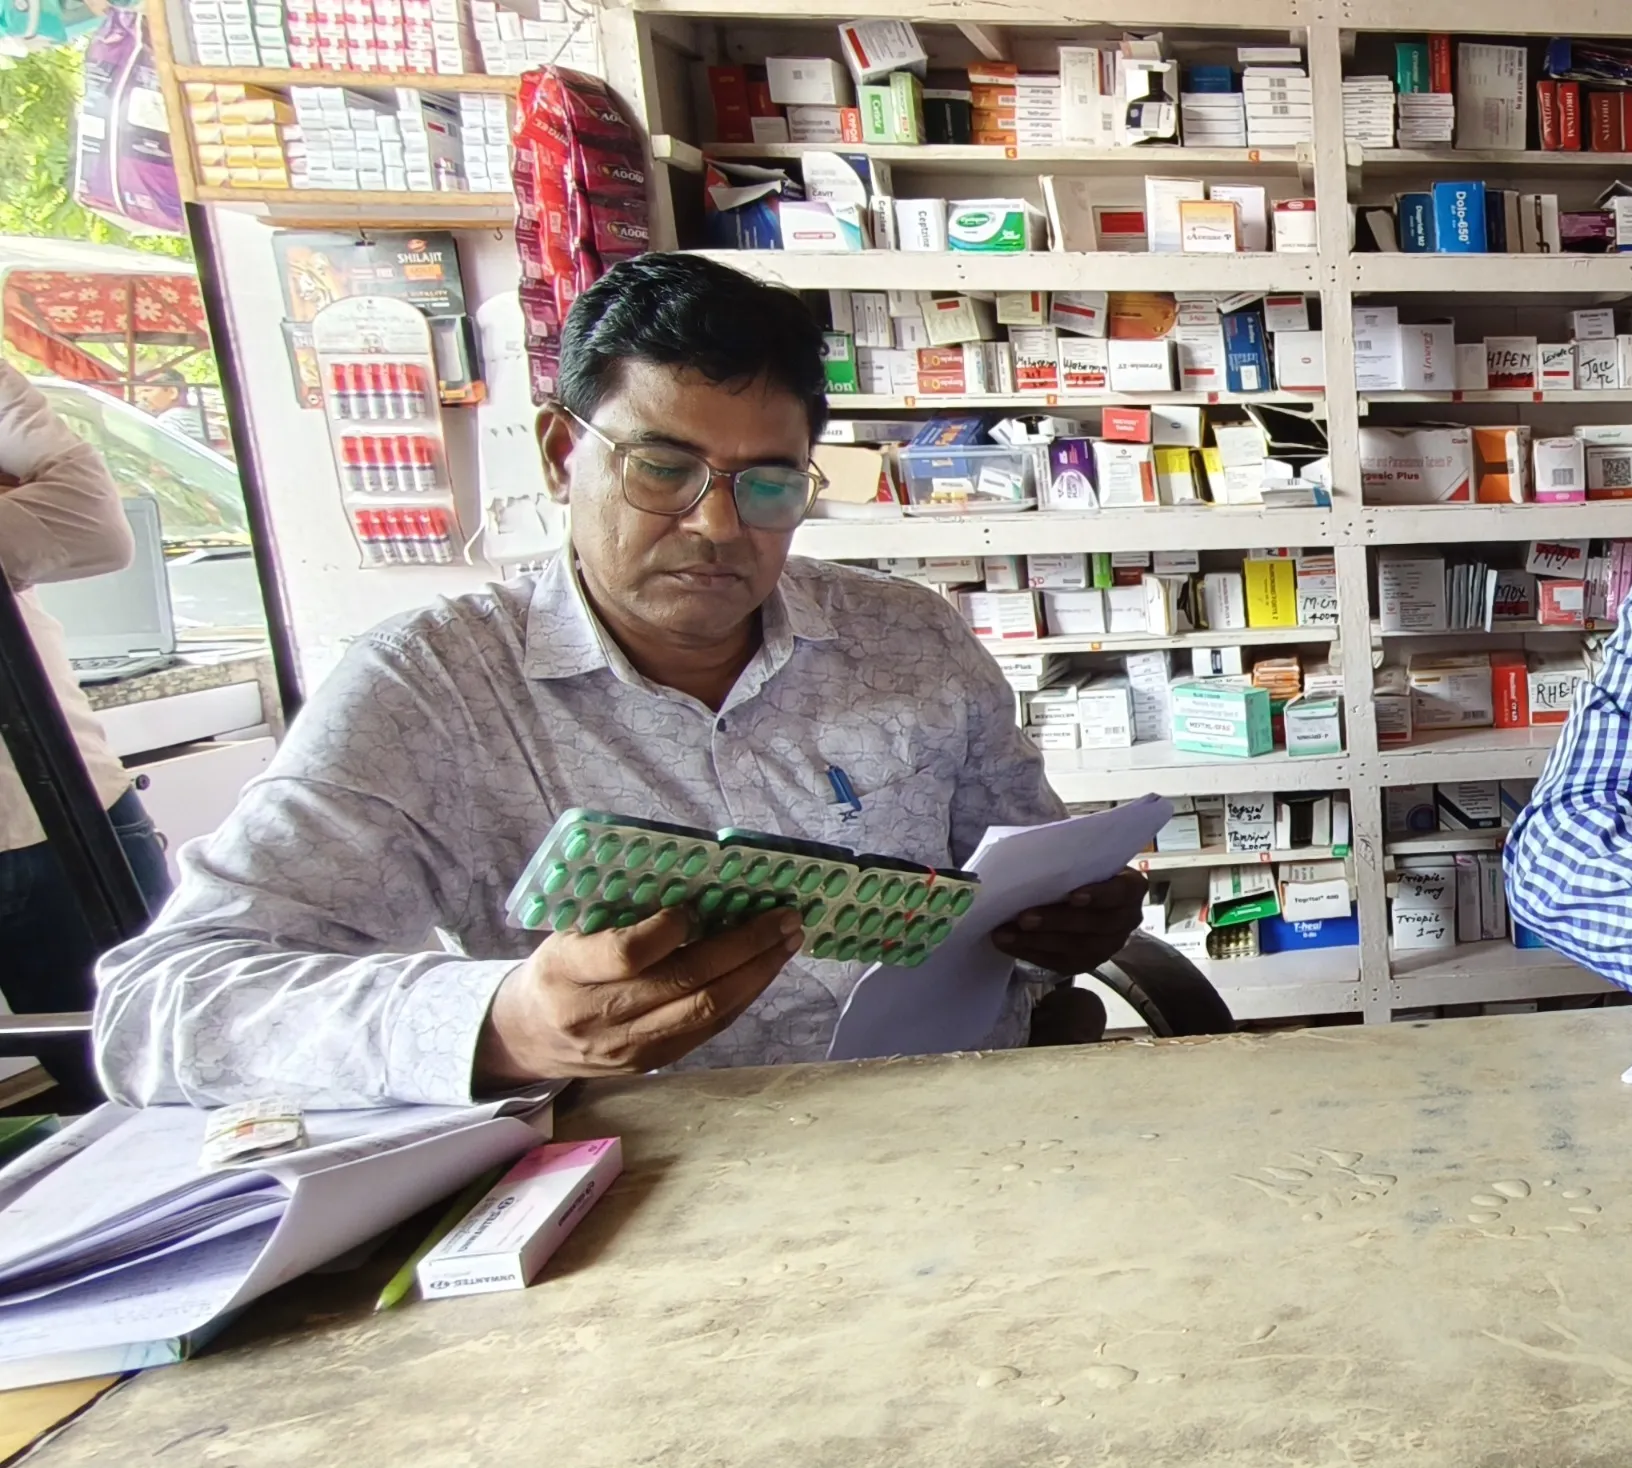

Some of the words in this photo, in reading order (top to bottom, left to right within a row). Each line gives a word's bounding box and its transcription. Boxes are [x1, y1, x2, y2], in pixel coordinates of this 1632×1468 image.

[1455, 191, 1468, 242] Dolo-650
[397, 252, 442, 265] SHILAJIT
[1396, 472, 1420, 480] Plus
